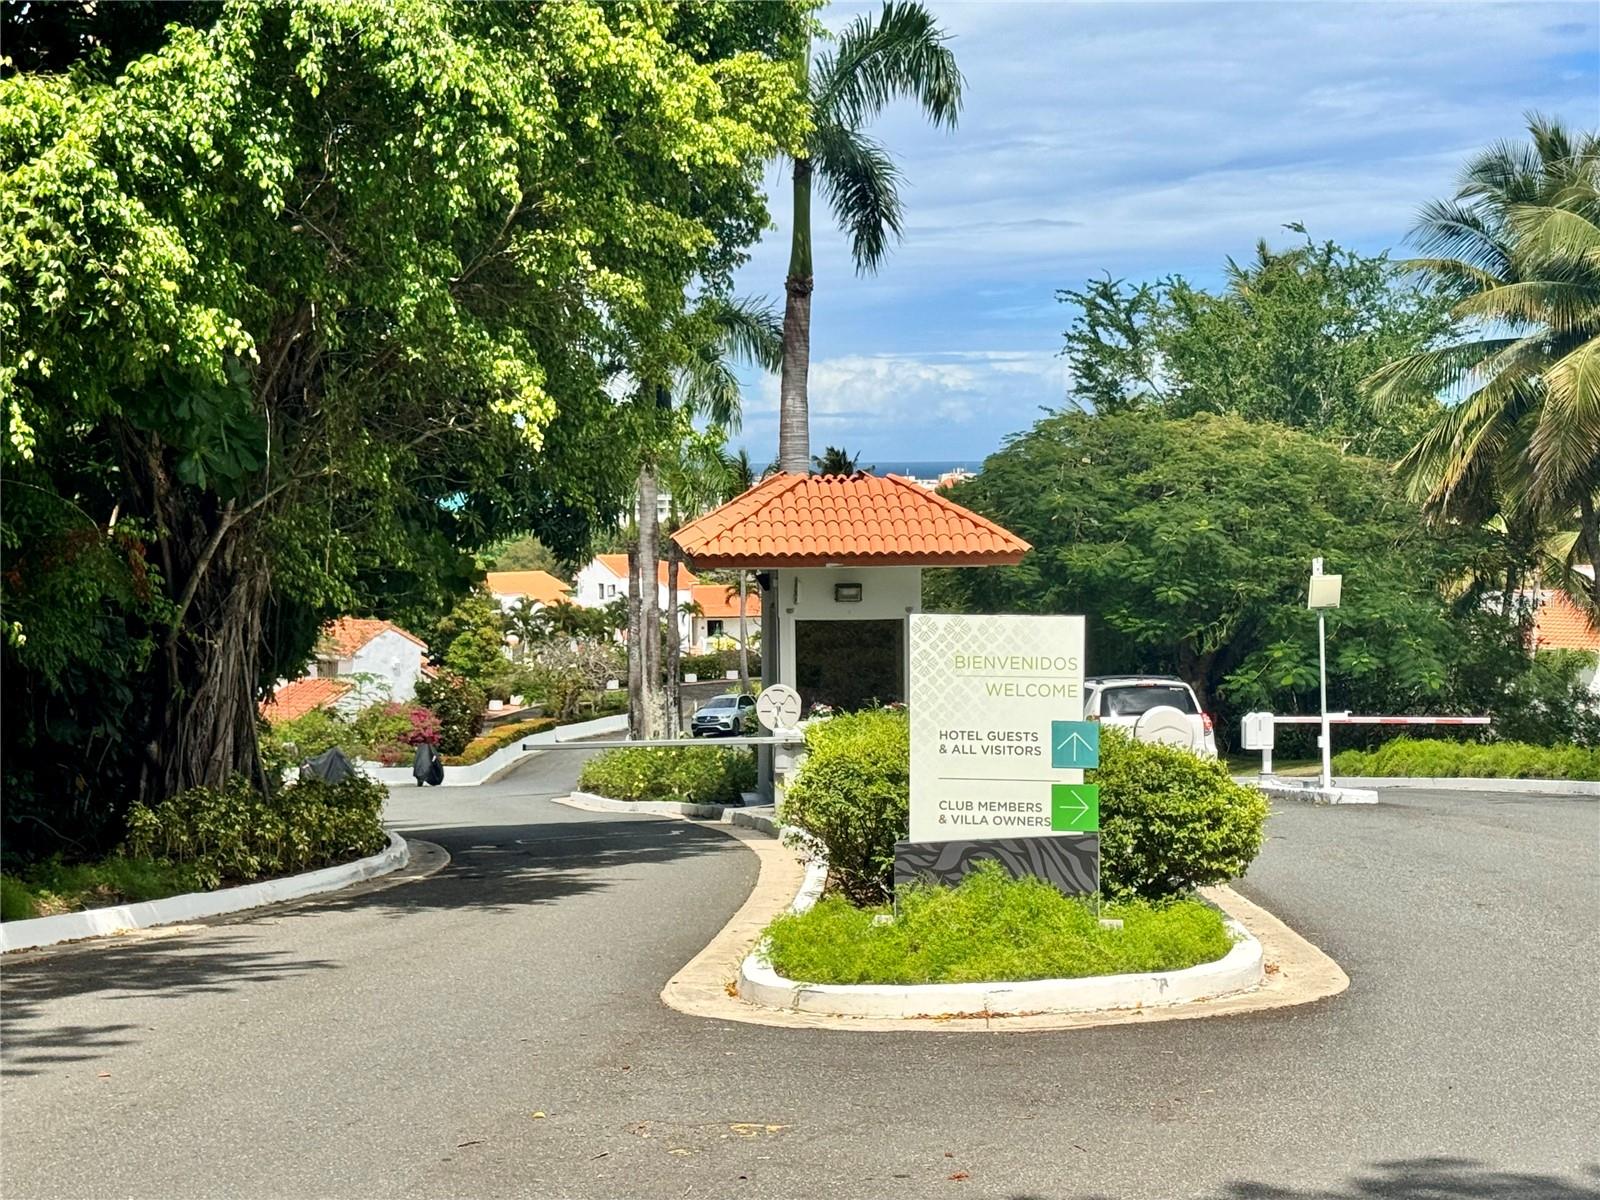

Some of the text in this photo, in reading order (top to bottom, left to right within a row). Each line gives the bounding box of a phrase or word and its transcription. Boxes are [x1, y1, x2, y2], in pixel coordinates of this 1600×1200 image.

[955, 655, 1078, 671] BIENVENIDOS
[986, 683, 1078, 698] WELCOME
[939, 730, 1039, 742] HOTEL GUESTS
[939, 744, 1042, 756] & ALL VISITORS
[938, 801, 1042, 813] CLUB MEMBERS
[938, 815, 1051, 827] & VILLA OWNERS
